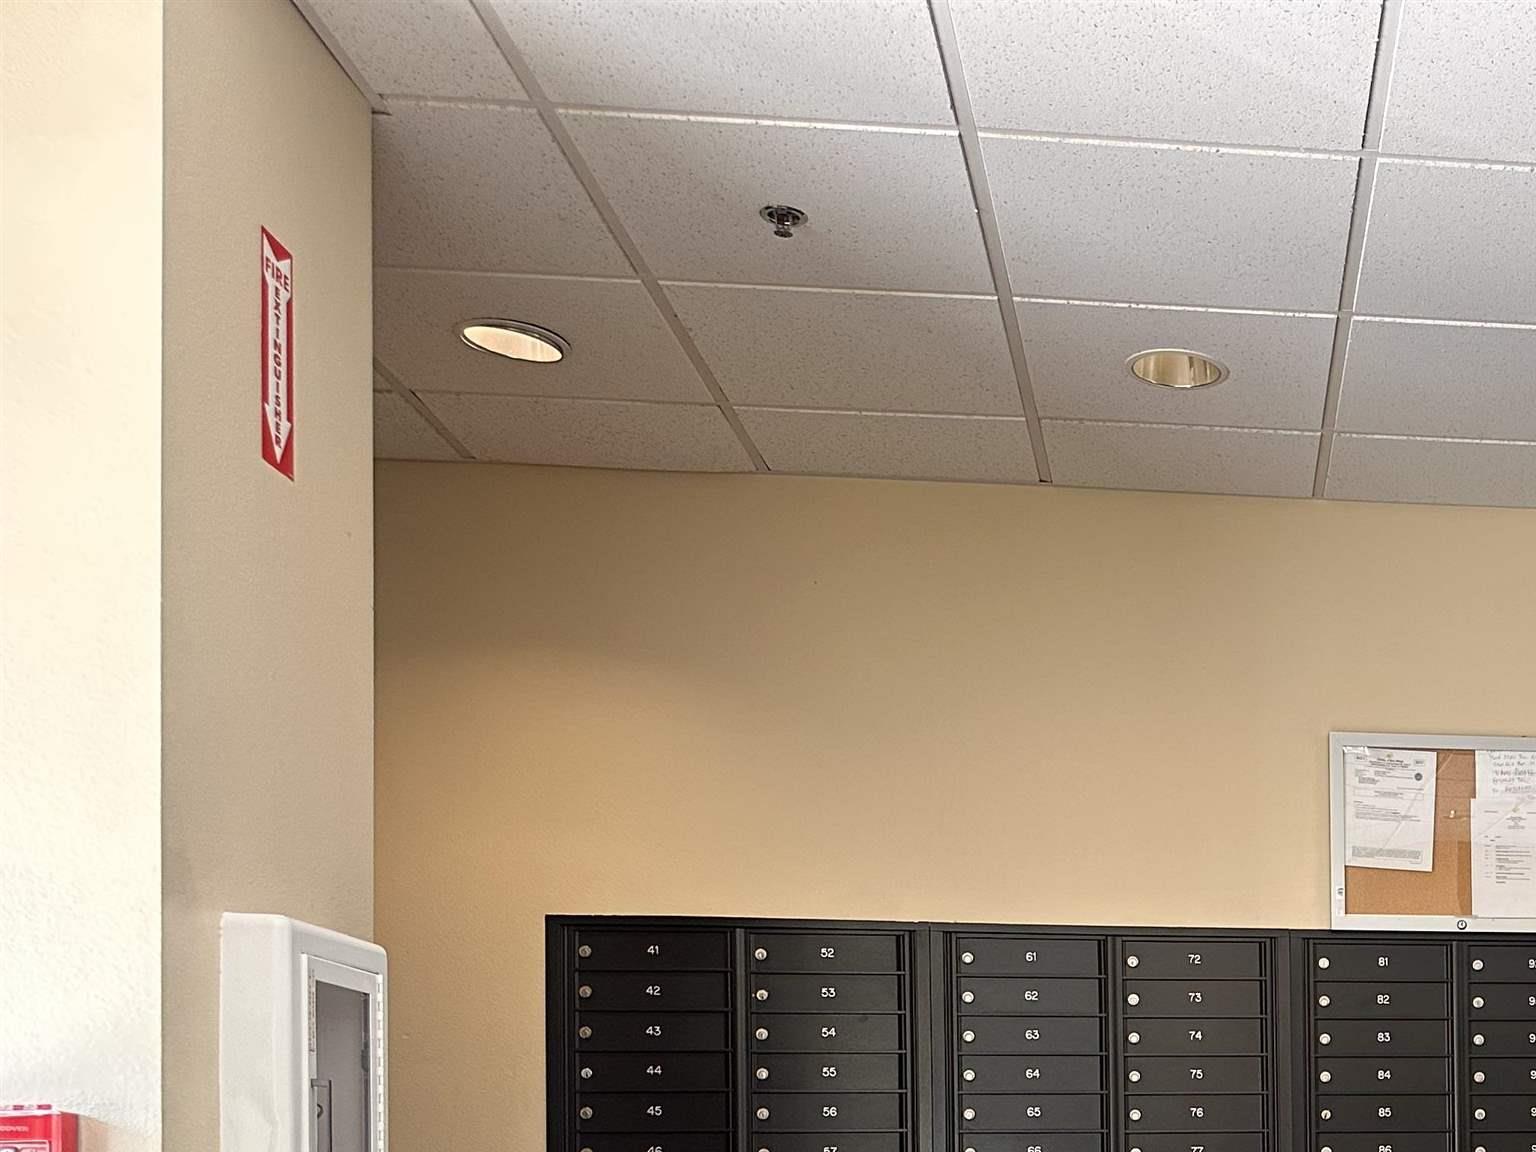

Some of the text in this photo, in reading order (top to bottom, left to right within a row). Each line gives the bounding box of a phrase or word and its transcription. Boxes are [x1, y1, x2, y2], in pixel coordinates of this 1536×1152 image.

[264, 256, 290, 293] FIRE
[273, 285, 283, 449] EXTINGUISHER
[647, 945, 659, 955] 41
[820, 947, 835, 958] 52
[1025, 951, 1037, 962] 61
[1188, 954, 1202, 964] 72
[1378, 956, 1389, 967] 81
[645, 985, 661, 996] 42
[821, 987, 836, 998] 53
[1024, 990, 1039, 1001] 62
[1188, 992, 1202, 1003] 73
[1377, 994, 1390, 1005] 82
[645, 1025, 662, 1037] 43
[821, 1027, 837, 1038] 54
[1025, 1029, 1040, 1040] 63
[1188, 1030, 1203, 1041] 74
[1377, 1032, 1391, 1042] 83
[646, 1065, 662, 1075] 44
[822, 1066, 837, 1077] 55
[1025, 1068, 1040, 1079] 64
[1189, 1069, 1203, 1079] 75
[1377, 1070, 1391, 1080] 84
[646, 1105, 663, 1116] 45
[822, 1106, 838, 1117] 56
[1026, 1106, 1041, 1117] 65
[1190, 1107, 1204, 1118] 76
[1378, 1107, 1392, 1118] 85
